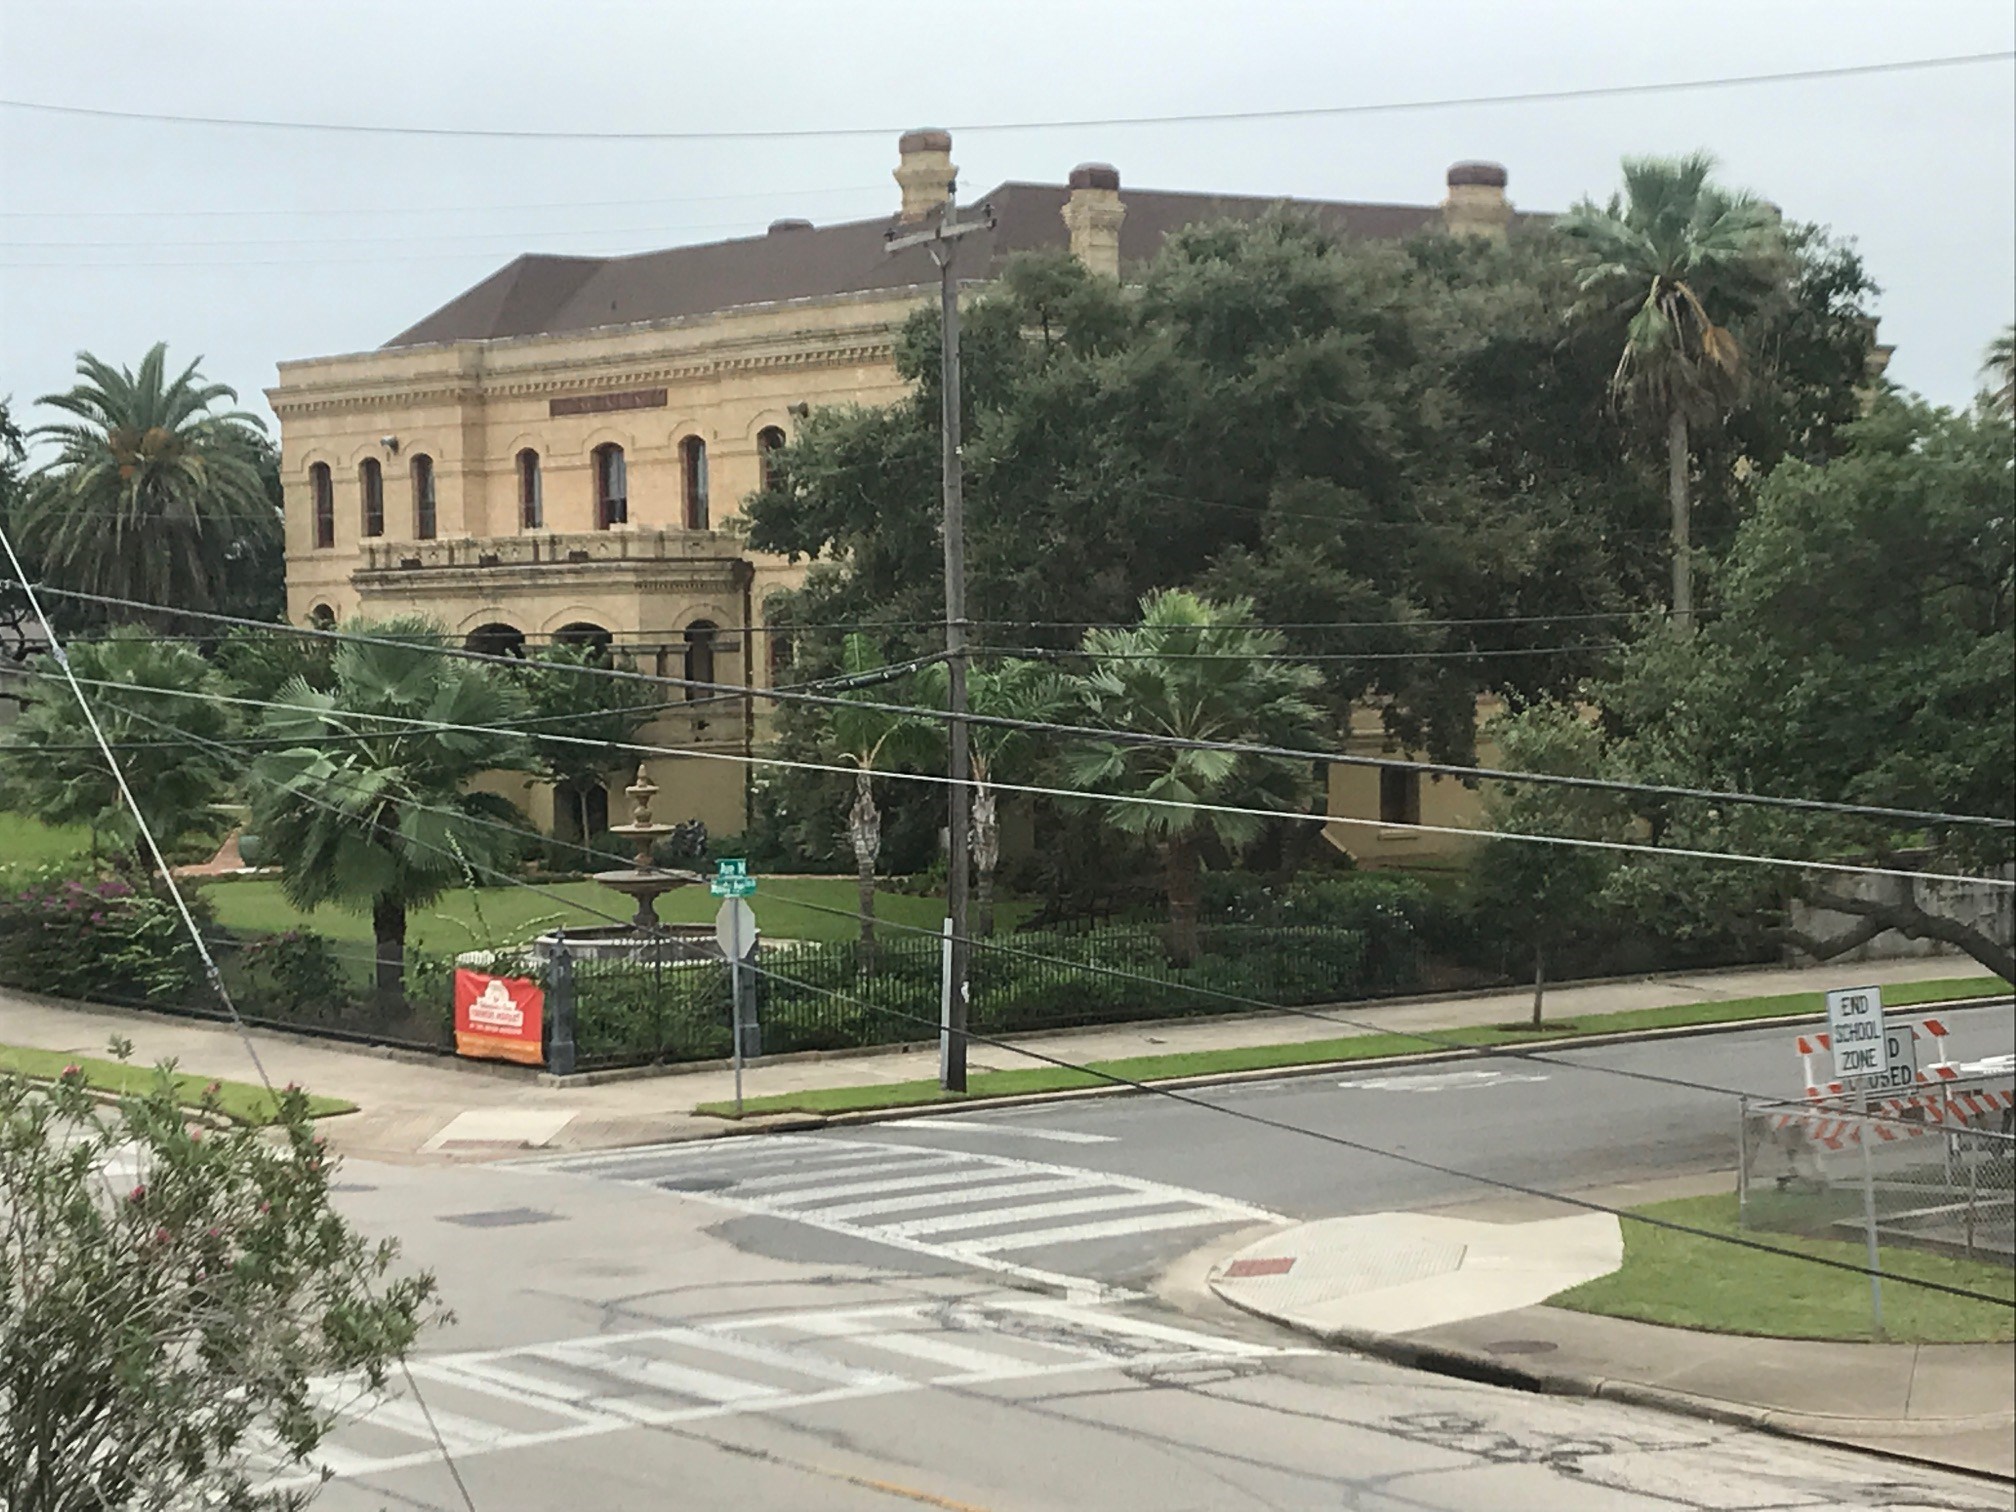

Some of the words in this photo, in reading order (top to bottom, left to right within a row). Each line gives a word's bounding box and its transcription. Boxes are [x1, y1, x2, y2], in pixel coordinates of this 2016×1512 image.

[1841, 995, 1868, 1016] END
[1835, 1021, 1880, 1043] SCHOOL
[1841, 1048, 1877, 1071] ZONE
